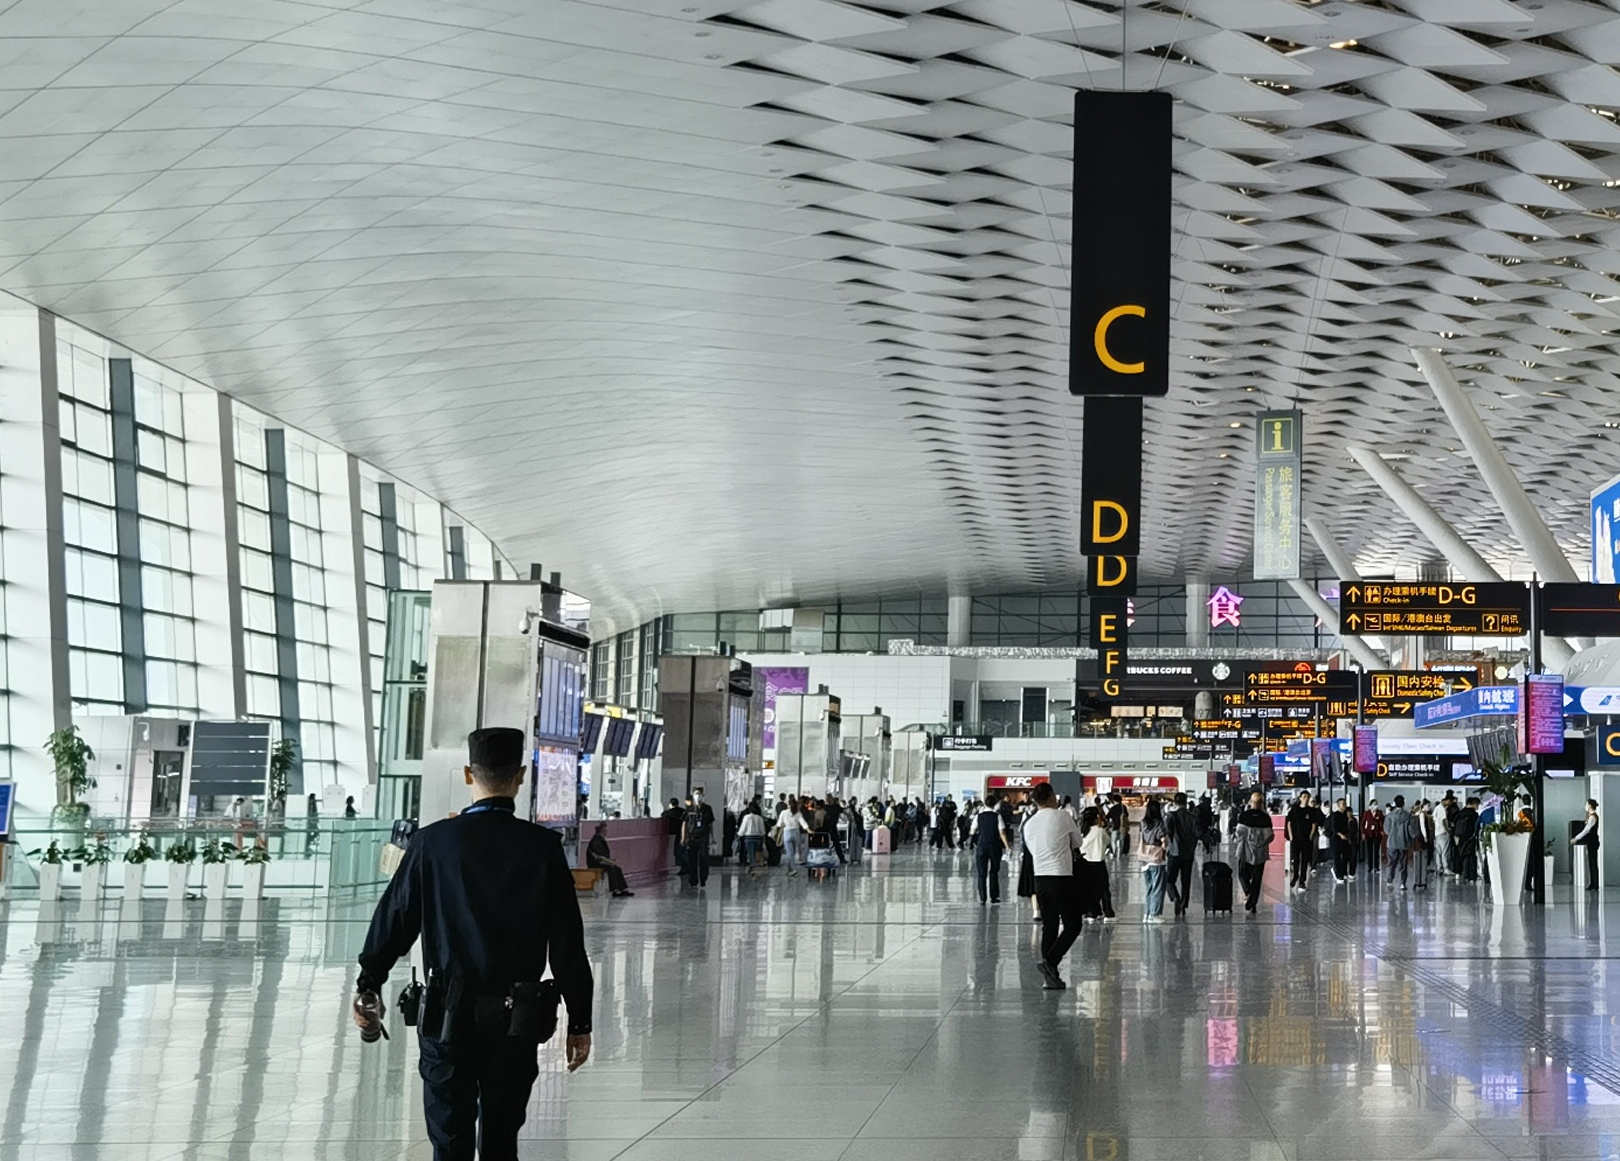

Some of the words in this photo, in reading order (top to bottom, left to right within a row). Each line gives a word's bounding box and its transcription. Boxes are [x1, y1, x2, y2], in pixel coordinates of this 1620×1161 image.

[1094, 305, 1146, 374] C
[1092, 500, 1129, 543] D
[1278, 466, 1293, 570] 旅客服务中心
[1097, 555, 1127, 587] D
[1383, 586, 1436, 596] 办理乘机手续
[1438, 586, 1476, 604] D-G
[1206, 586, 1244, 628] 食
[1500, 614, 1519, 624] 问讯
[1100, 615, 1117, 642] E
[1106, 651, 1119, 674] F
[1127, 666, 1159, 675] BUCKS
[1160, 666, 1193, 675] COFFEE
[1303, 672, 1326, 684] D-G
[1103, 679, 1119, 696] G
[1377, 762, 1388, 777] D
[1006, 776, 1032, 787] KFC
